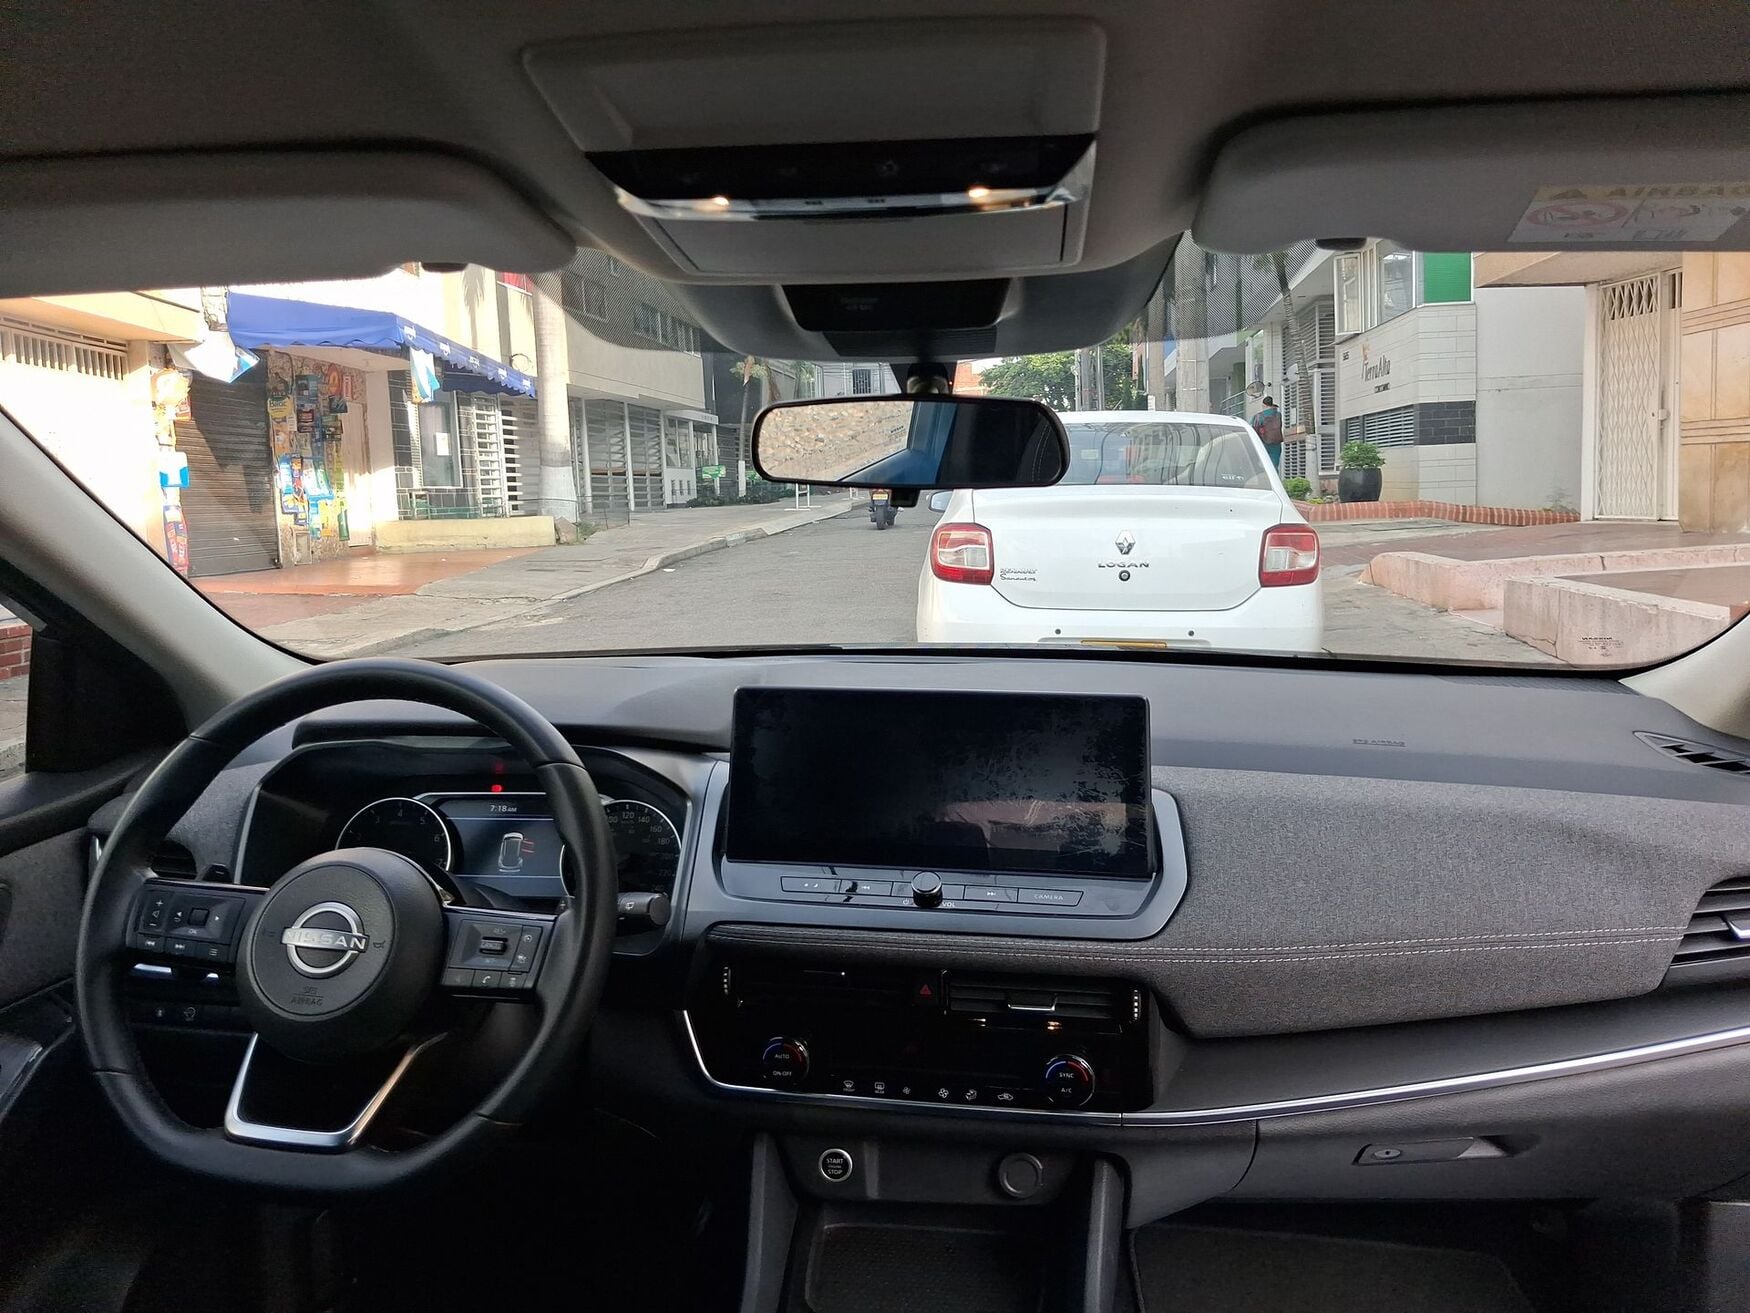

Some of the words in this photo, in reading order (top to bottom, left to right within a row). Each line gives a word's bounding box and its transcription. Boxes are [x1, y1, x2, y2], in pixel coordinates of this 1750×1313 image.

[1098, 561, 1150, 569] LOGAN
[622, 811, 635, 819] 120
[639, 816, 650, 824] 140
[650, 825, 663, 833] 160
[658, 838, 670, 846] 180
[1033, 893, 1064, 901] CAMERA
[286, 930, 367, 951] NISSAN
[290, 996, 324, 1006] AIRBAG
